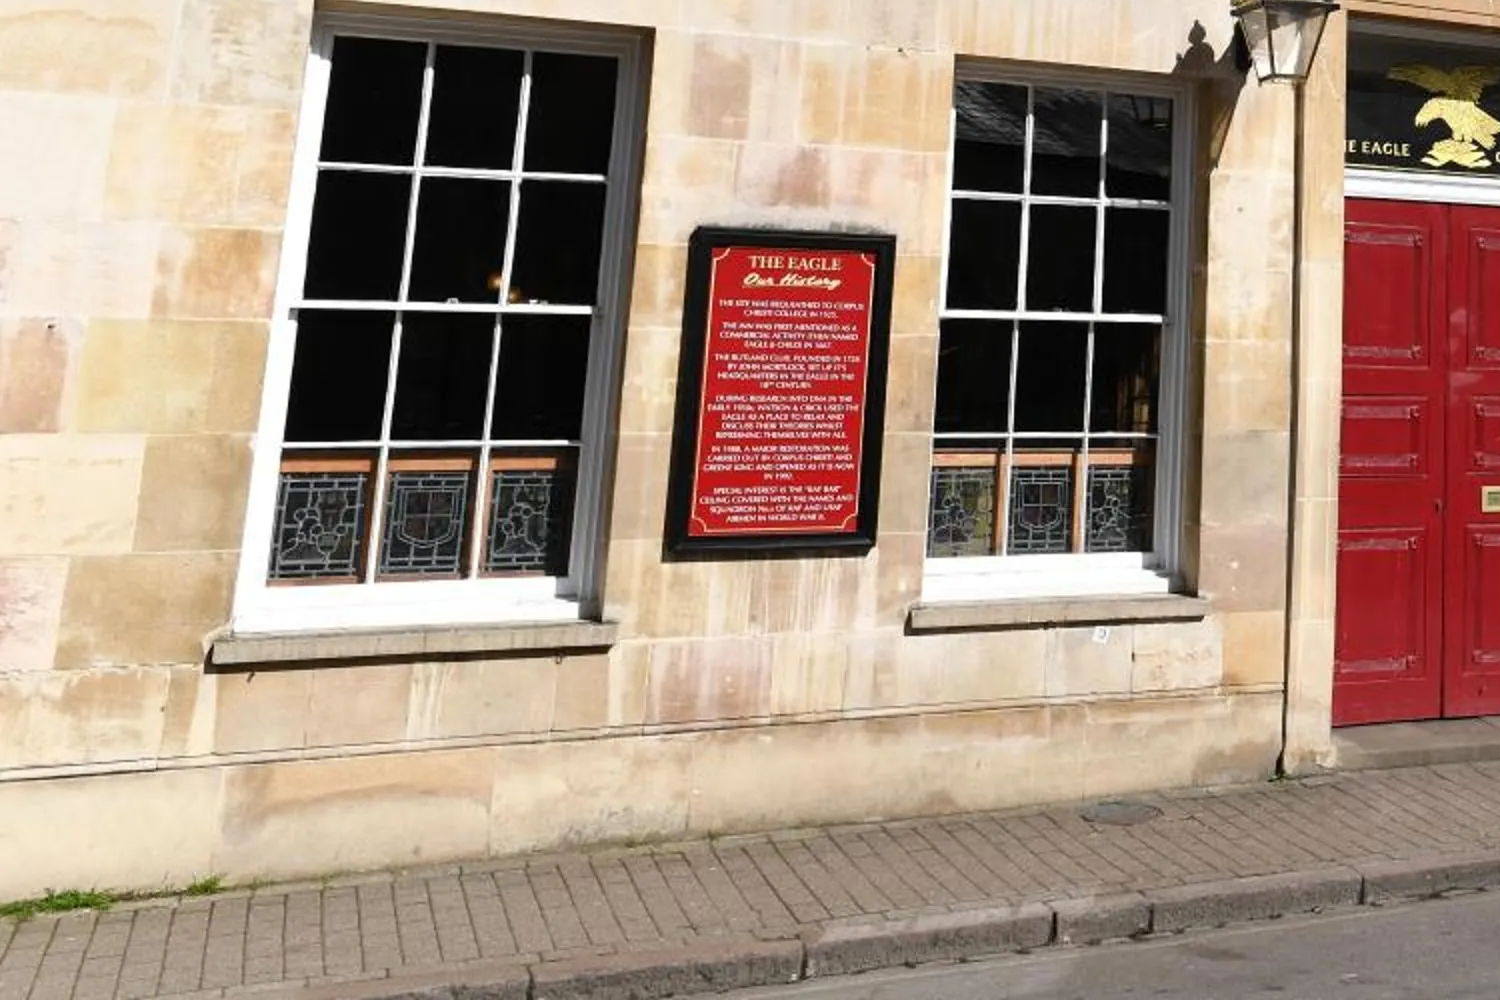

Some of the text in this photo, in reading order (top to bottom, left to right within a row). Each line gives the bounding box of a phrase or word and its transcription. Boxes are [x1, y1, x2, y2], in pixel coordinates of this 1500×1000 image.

[1361, 140, 1412, 157] EAGLE
[748, 256, 842, 270] THE EAGLE
[743, 272, 841, 290] Our History
